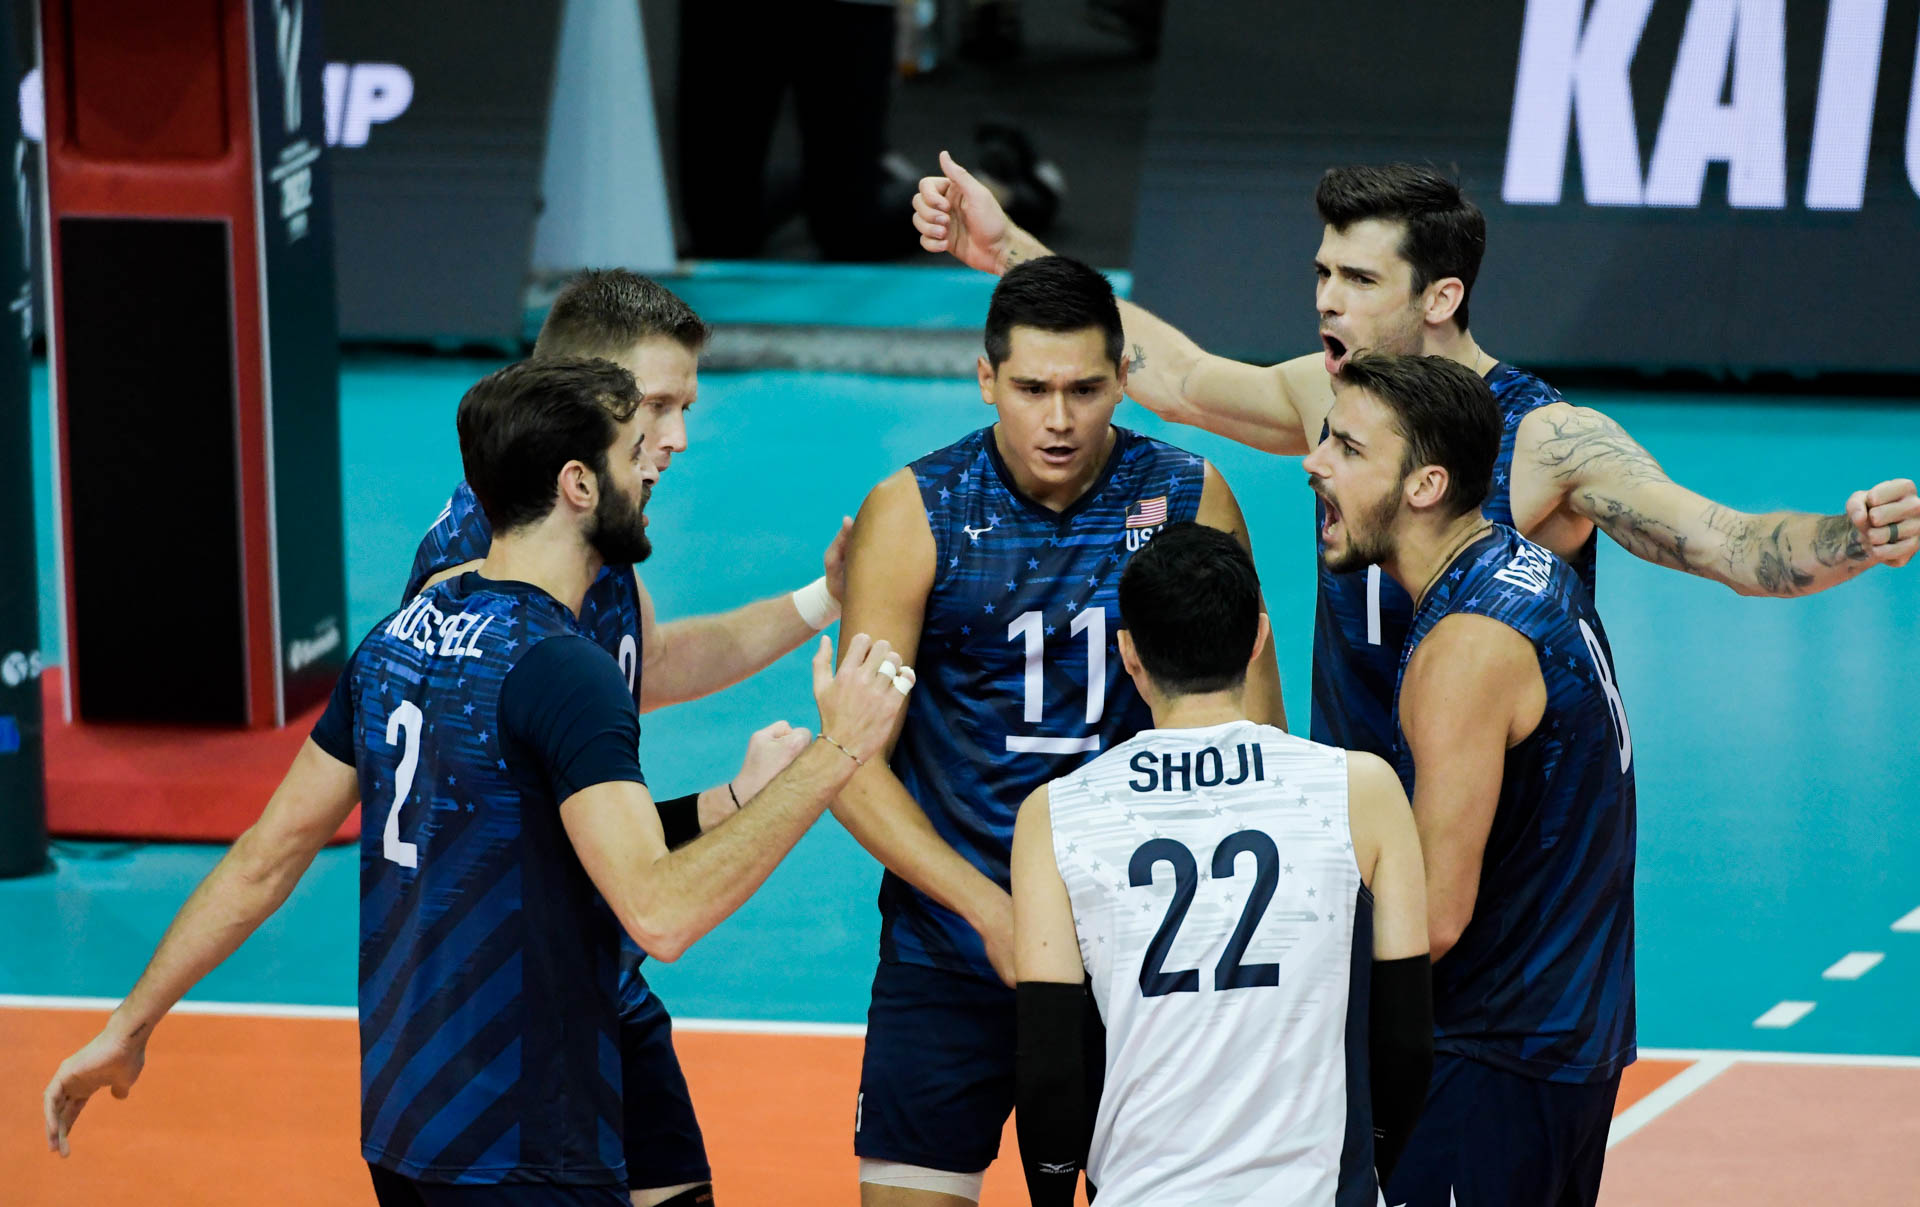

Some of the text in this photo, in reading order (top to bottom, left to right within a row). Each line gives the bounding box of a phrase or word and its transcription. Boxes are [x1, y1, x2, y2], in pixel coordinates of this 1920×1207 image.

[1007, 607, 1106, 724] 11
[383, 699, 424, 868] 2
[1128, 743, 1265, 792] SHOJI
[1128, 829, 1280, 997] 22
